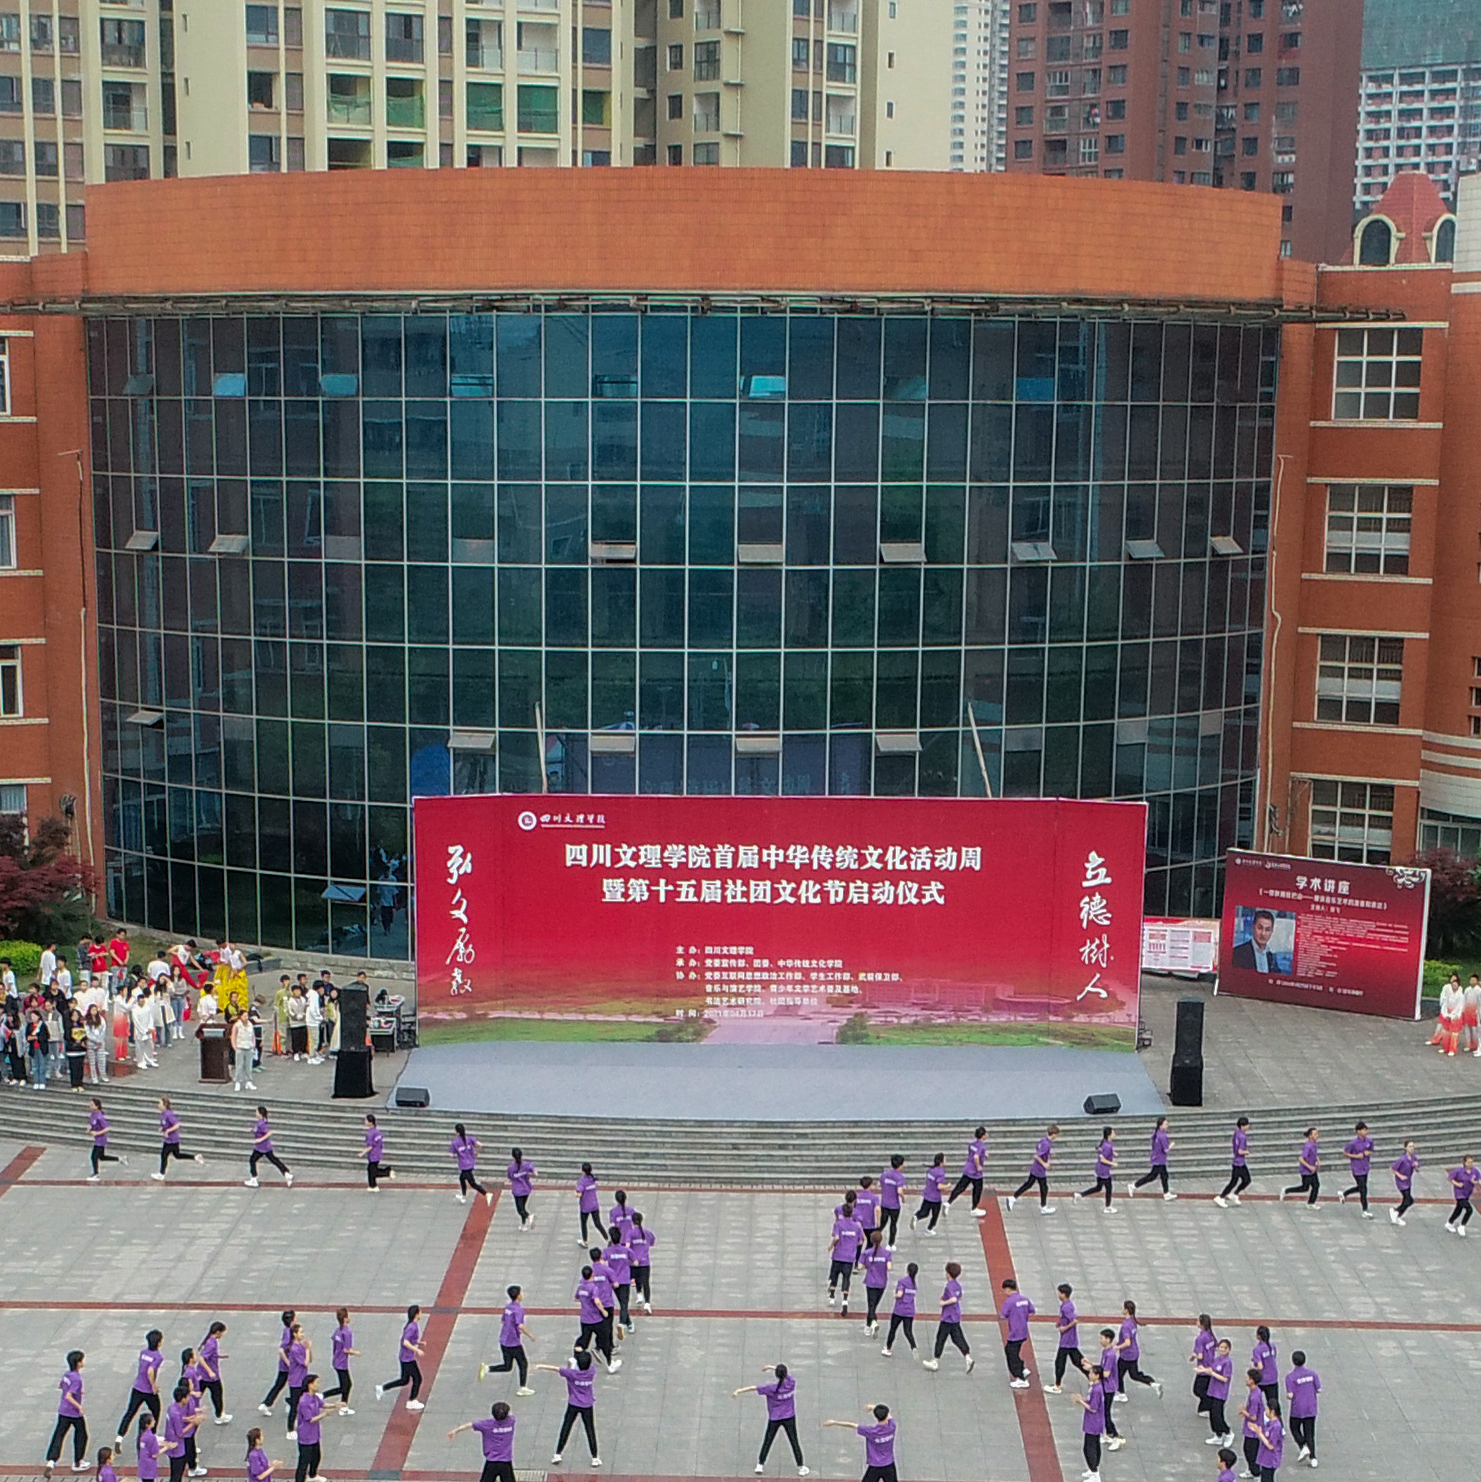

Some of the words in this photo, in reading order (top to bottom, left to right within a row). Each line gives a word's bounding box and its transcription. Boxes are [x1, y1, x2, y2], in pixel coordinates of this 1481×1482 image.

[565, 844, 982, 871] 四川文理学院首届中华传统文化活动周
[602, 878, 945, 905] 暨第十五届社团文化节启动仪式
[1295, 875, 1351, 896] 学术讲座
